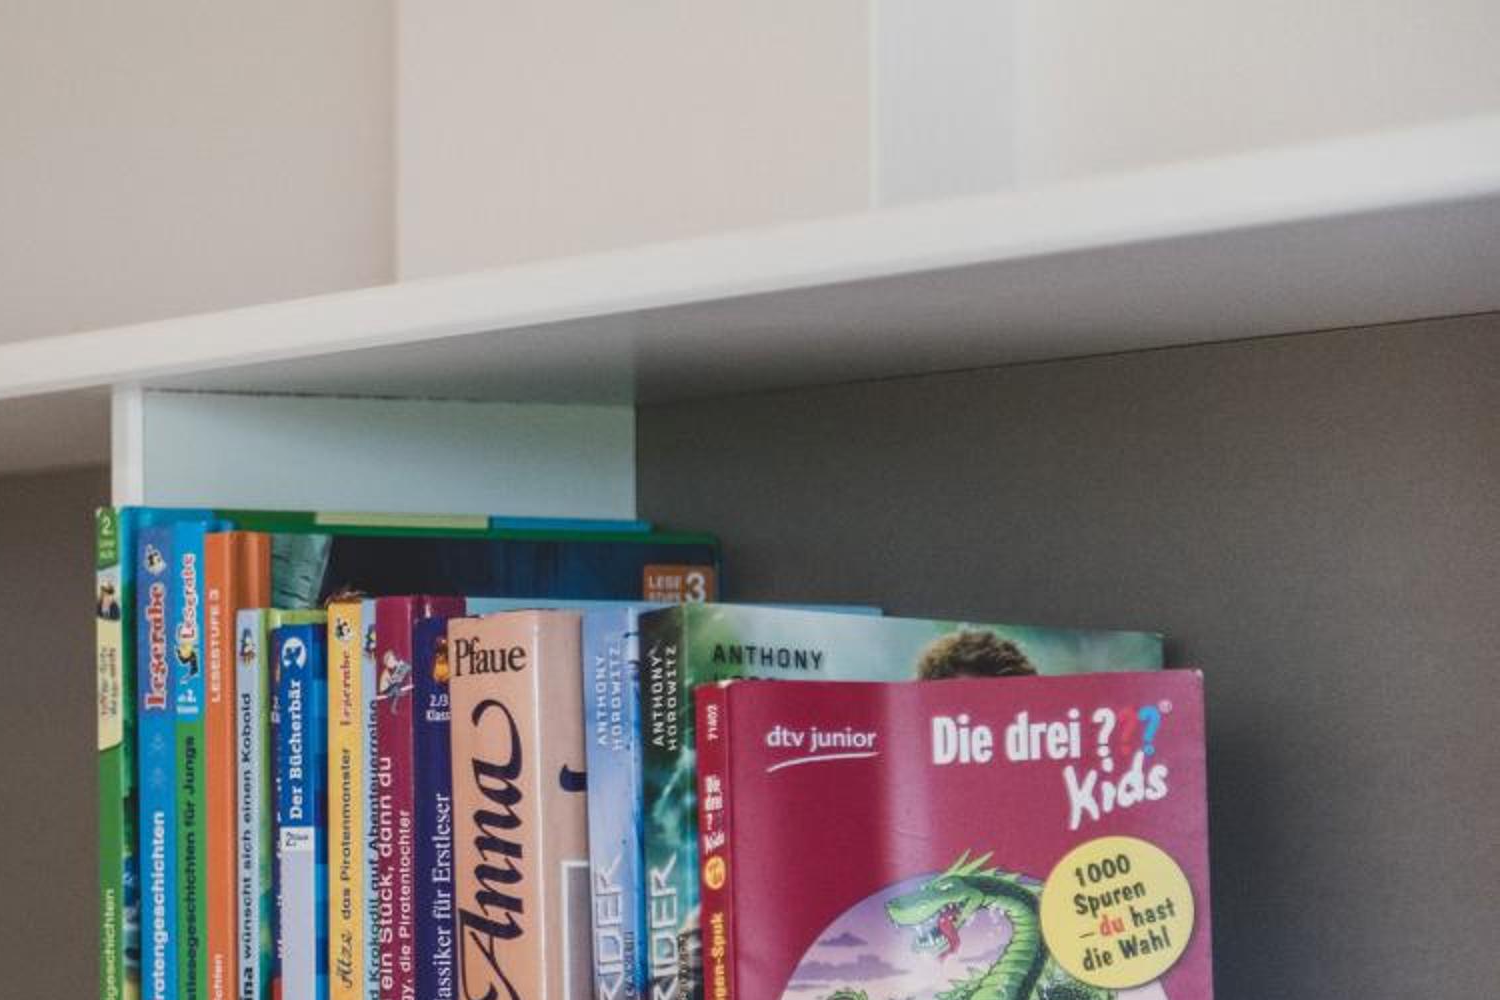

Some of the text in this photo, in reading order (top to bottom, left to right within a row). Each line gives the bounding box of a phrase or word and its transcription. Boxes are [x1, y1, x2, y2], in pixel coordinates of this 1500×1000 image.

[176, 553, 198, 640] Leserabe
[144, 583, 167, 710] Leserabe
[210, 589, 221, 703] LESESTUFE 3
[455, 637, 527, 676] Pfaue
[712, 643, 823, 670] ANTHONY
[340, 650, 351, 725] Leserabe
[595, 656, 608, 746] ANTHONY
[608, 646, 623, 750] HOROWITZ
[651, 657, 664, 746] ANTHONY
[665, 645, 677, 750] HOROWITZ
[241, 693, 252, 763] Kobold
[289, 679, 303, 778] Bücherbär
[767, 725, 877, 753] dtv junior
[932, 714, 993, 765] Die
[1005, 708, 1081, 762] drei
[184, 736, 198, 795] Jungs
[367, 700, 380, 849] Abenteuerreise
[378, 757, 391, 787] du
[1063, 750, 1169, 831] Kids
[184, 802, 195, 827] für
[242, 770, 252, 824] einen
[290, 786, 303, 820] Der
[340, 748, 351, 881] Piratenmonster
[242, 830, 252, 864] sich
[379, 798, 392, 857] dann
[431, 793, 451, 883] Erstleser
[368, 861, 379, 892] auf
[399, 810, 411, 936] Piratentochter
[1073, 882, 1146, 918] Spuren
[1075, 854, 1131, 887] 1000
[241, 878, 252, 959] wünscht
[340, 889, 351, 920] das
[379, 865, 394, 943] Stück,
[432, 890, 451, 919] für
[1100, 914, 1125, 937] du
[1129, 898, 1175, 927] hast
[368, 899, 380, 982] Krokodil
[399, 943, 411, 972] die
[1082, 925, 1171, 972] die Wahl
[380, 954, 393, 989] ein
